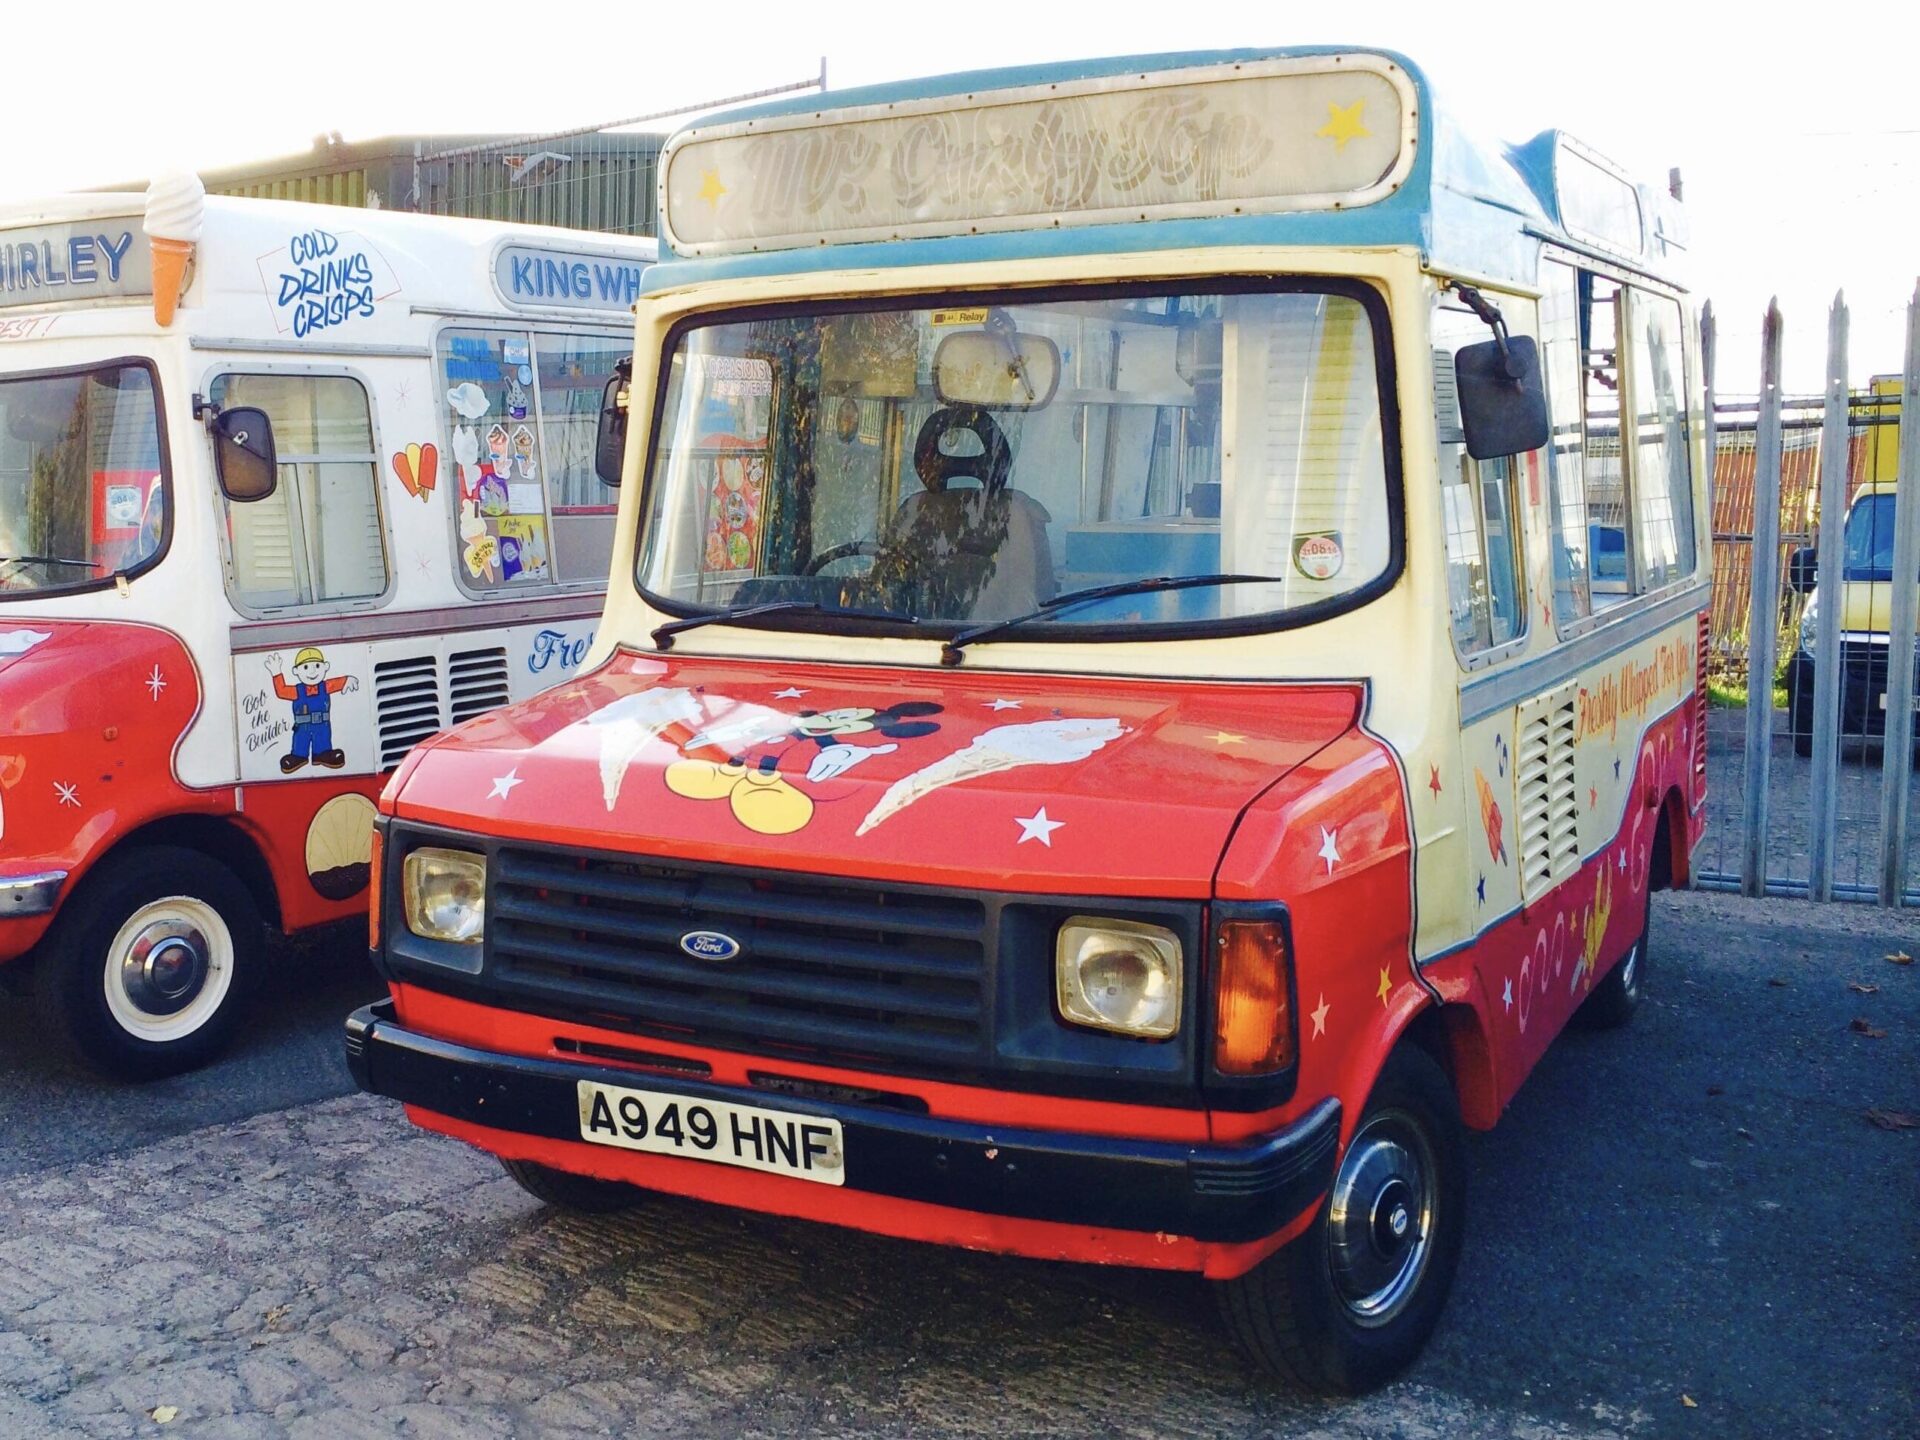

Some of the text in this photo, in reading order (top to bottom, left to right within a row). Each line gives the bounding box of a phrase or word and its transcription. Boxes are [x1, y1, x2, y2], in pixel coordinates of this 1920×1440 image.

[0, 231, 133, 293] IRLEY
[291, 229, 338, 265] COLD
[279, 253, 372, 307] DRINKS
[511, 256, 592, 298] KING
[293, 286, 374, 338] CRISPS
[959, 312, 985, 322] Relay
[243, 689, 268, 715] Bob
[1574, 672, 1618, 745] Freshly
[1620, 648, 1660, 719] Whipped
[246, 718, 290, 752] Builder
[251, 710, 270, 729] the
[693, 936, 725, 953] Ford
[590, 1090, 833, 1171] A949 HNF
